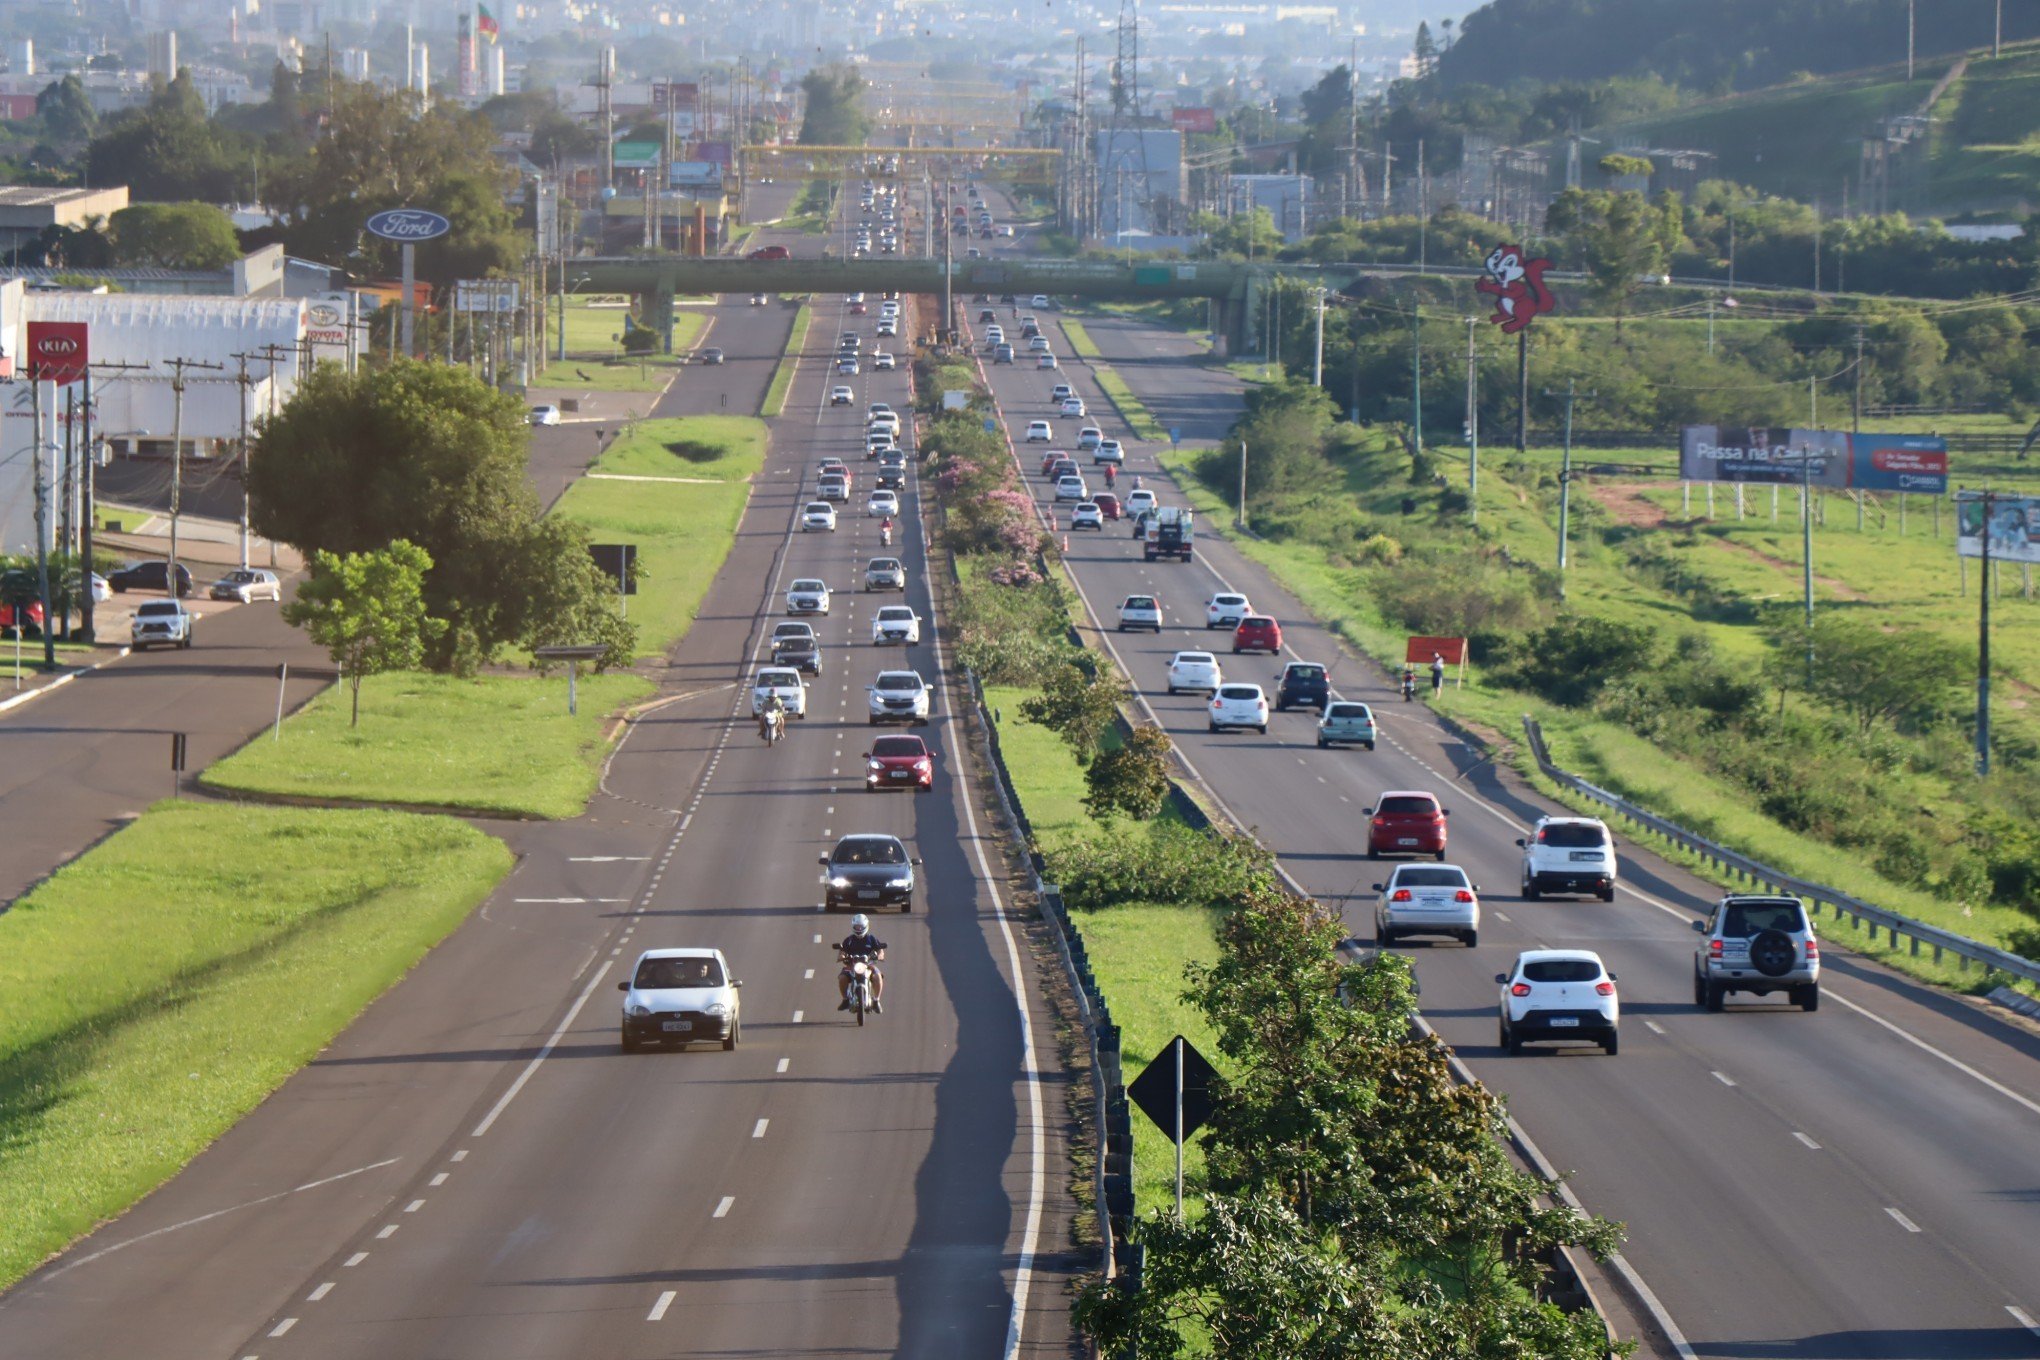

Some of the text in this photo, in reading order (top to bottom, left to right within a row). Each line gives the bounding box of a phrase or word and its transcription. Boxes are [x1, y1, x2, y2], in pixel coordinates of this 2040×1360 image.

[383, 214, 434, 235] Ford
[307, 330, 343, 339] TOYOTA
[44, 340, 71, 352] KIA
[1697, 442, 1743, 460] Passa
[1748, 447, 1768, 461] na
